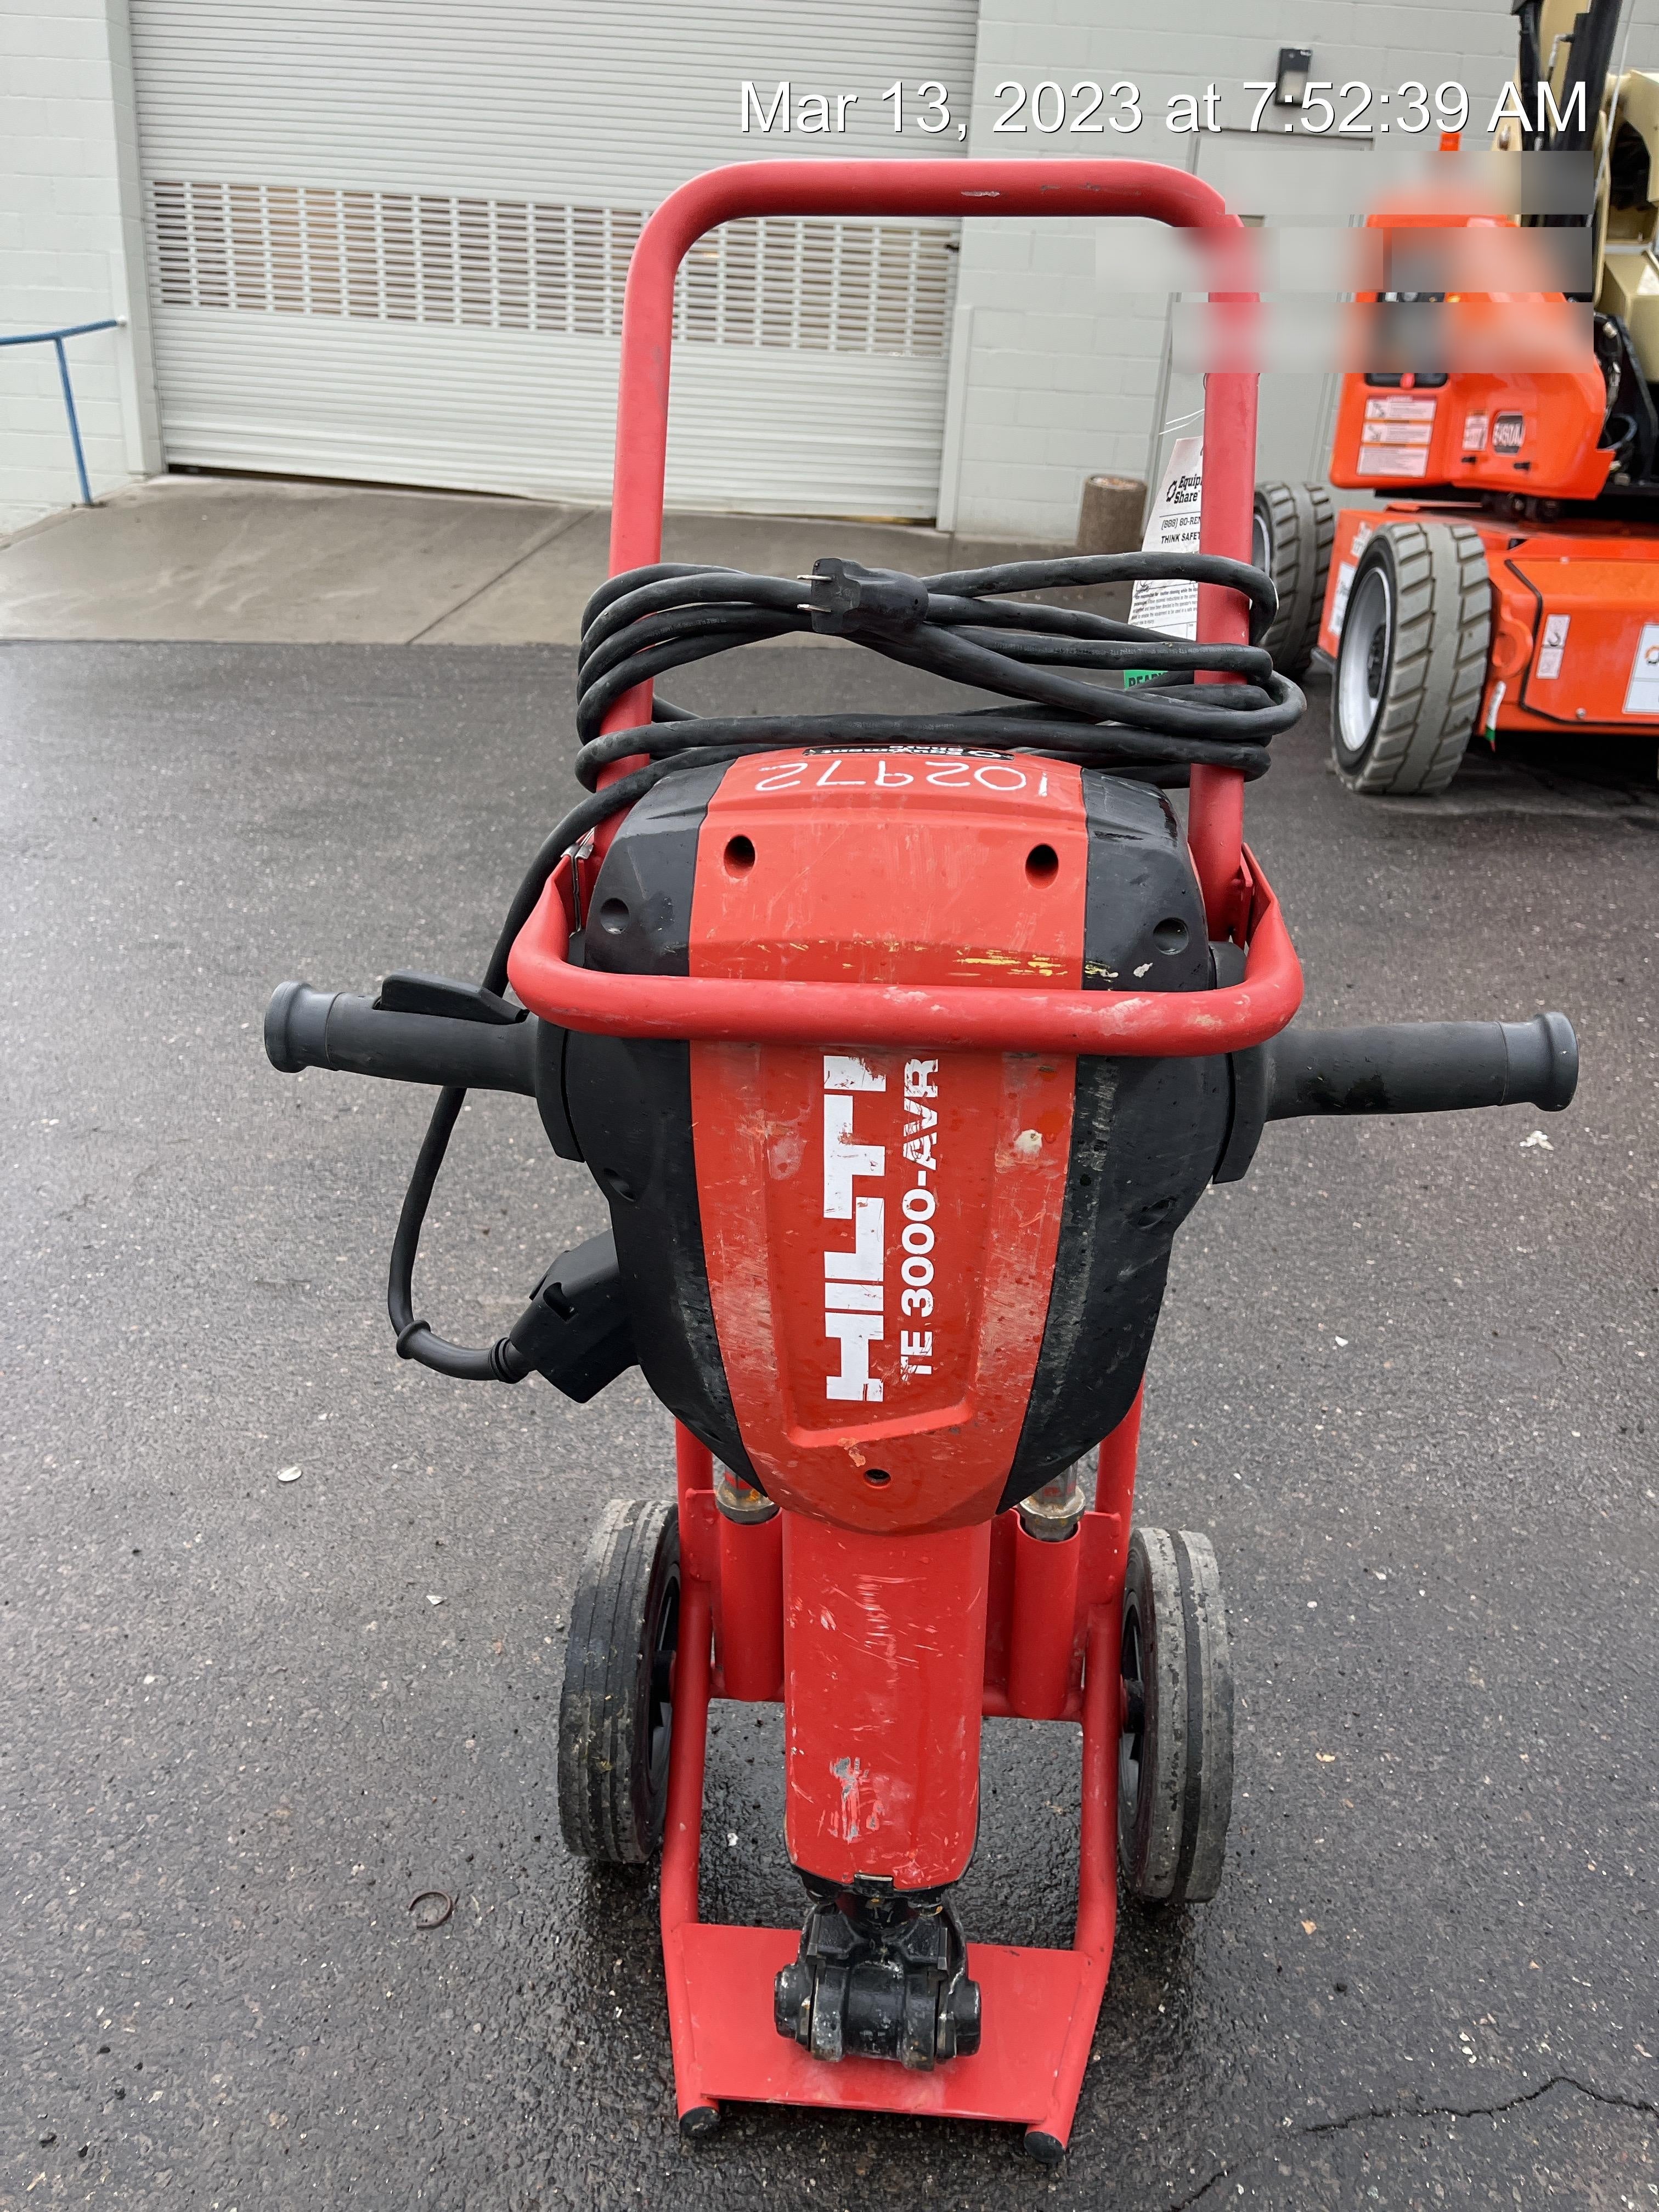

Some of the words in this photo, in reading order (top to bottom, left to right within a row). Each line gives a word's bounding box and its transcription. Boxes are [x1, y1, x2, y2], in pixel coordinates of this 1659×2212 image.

[1174, 490, 1198, 504] Share
[1178, 473, 1201, 490] Equip
[1161, 533, 1180, 544] THINK
[755, 760, 1048, 797] 102972
[901, 1058, 939, 1318] 3000-AVR
[823, 1055, 886, 1402] HILTI
[900, 1330, 933, 1381] TE
